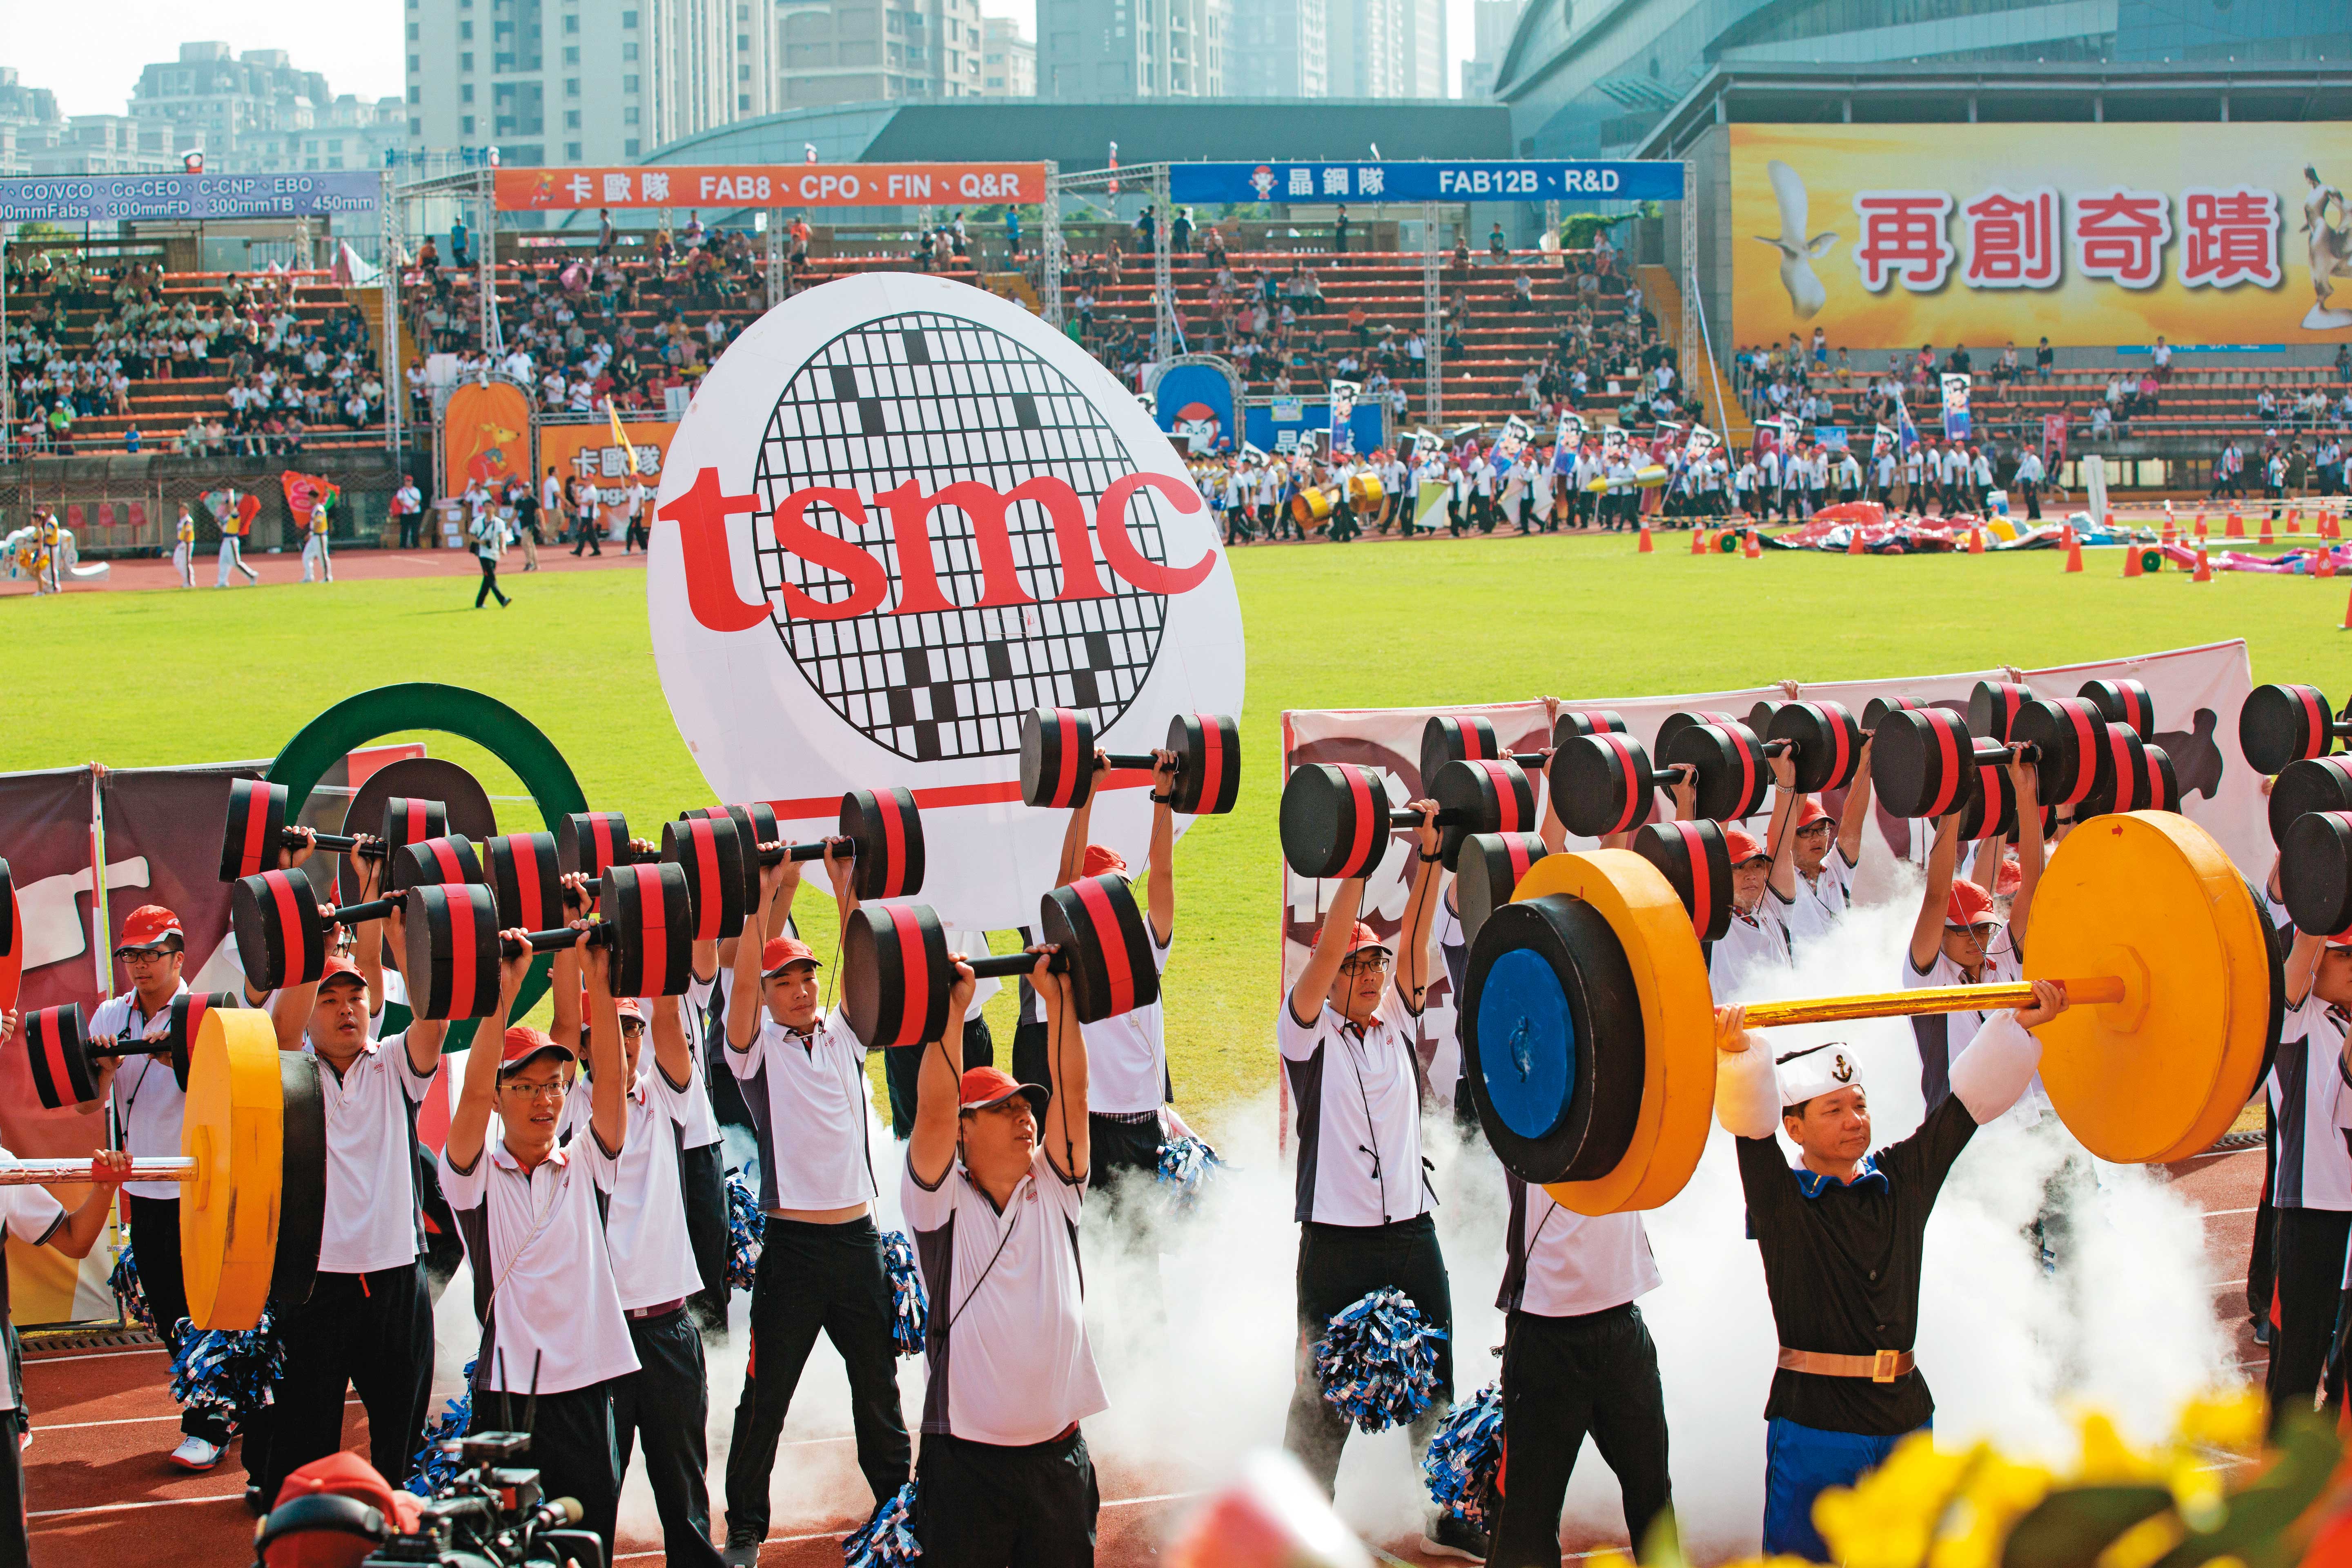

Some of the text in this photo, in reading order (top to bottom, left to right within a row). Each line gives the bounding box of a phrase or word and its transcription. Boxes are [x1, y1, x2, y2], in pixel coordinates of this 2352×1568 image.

[565, 173, 670, 203] 卡歐隊
[958, 173, 1020, 198] Q&R
[1288, 167, 1385, 196] 晶鋼隊
[1564, 169, 1619, 193] R&D
[312, 196, 373, 211] 450mm
[1860, 189, 2273, 283] 再創奇蹟
[657, 467, 1217, 632] tsmc
